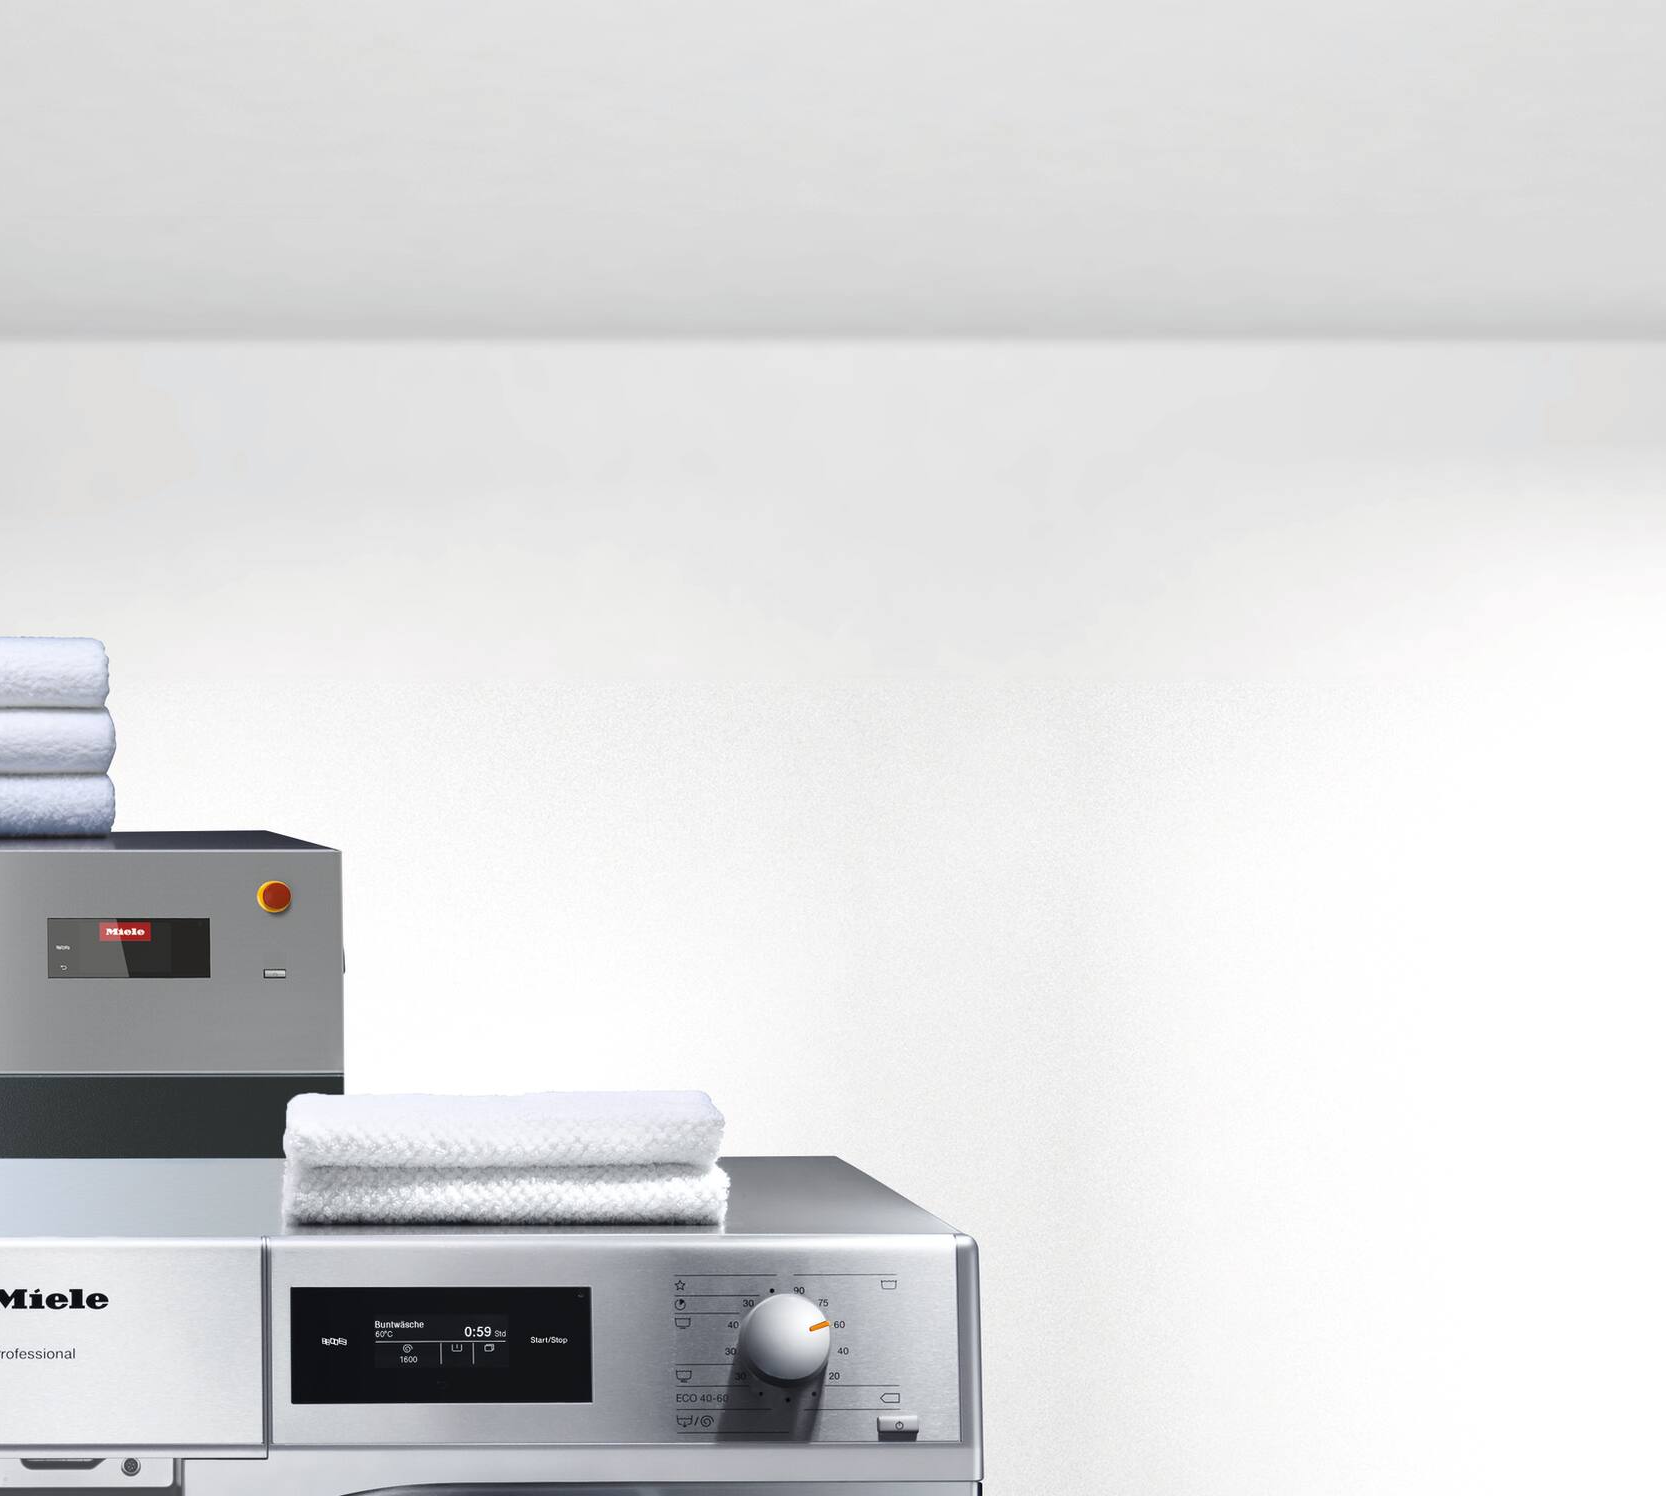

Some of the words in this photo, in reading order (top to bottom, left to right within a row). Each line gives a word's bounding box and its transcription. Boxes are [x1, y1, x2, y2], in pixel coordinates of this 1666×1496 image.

[106, 928, 145, 936] Miele
[794, 1287, 805, 1295] 90
[743, 1299, 754, 1308] 30
[819, 1299, 829, 1307] 75
[374, 1321, 424, 1329] Buntwäsche
[728, 1321, 740, 1329] 40
[834, 1321, 845, 1329] 60
[464, 1326, 492, 1337] 0:59
[530, 1336, 568, 1344] Start/Stop
[725, 1348, 737, 1356] 30
[837, 1347, 849, 1355] 40
[735, 1372, 747, 1381] 30
[828, 1372, 840, 1380] 20
[676, 1394, 698, 1403] ECO
[699, 1394, 729, 1403] 40-60
